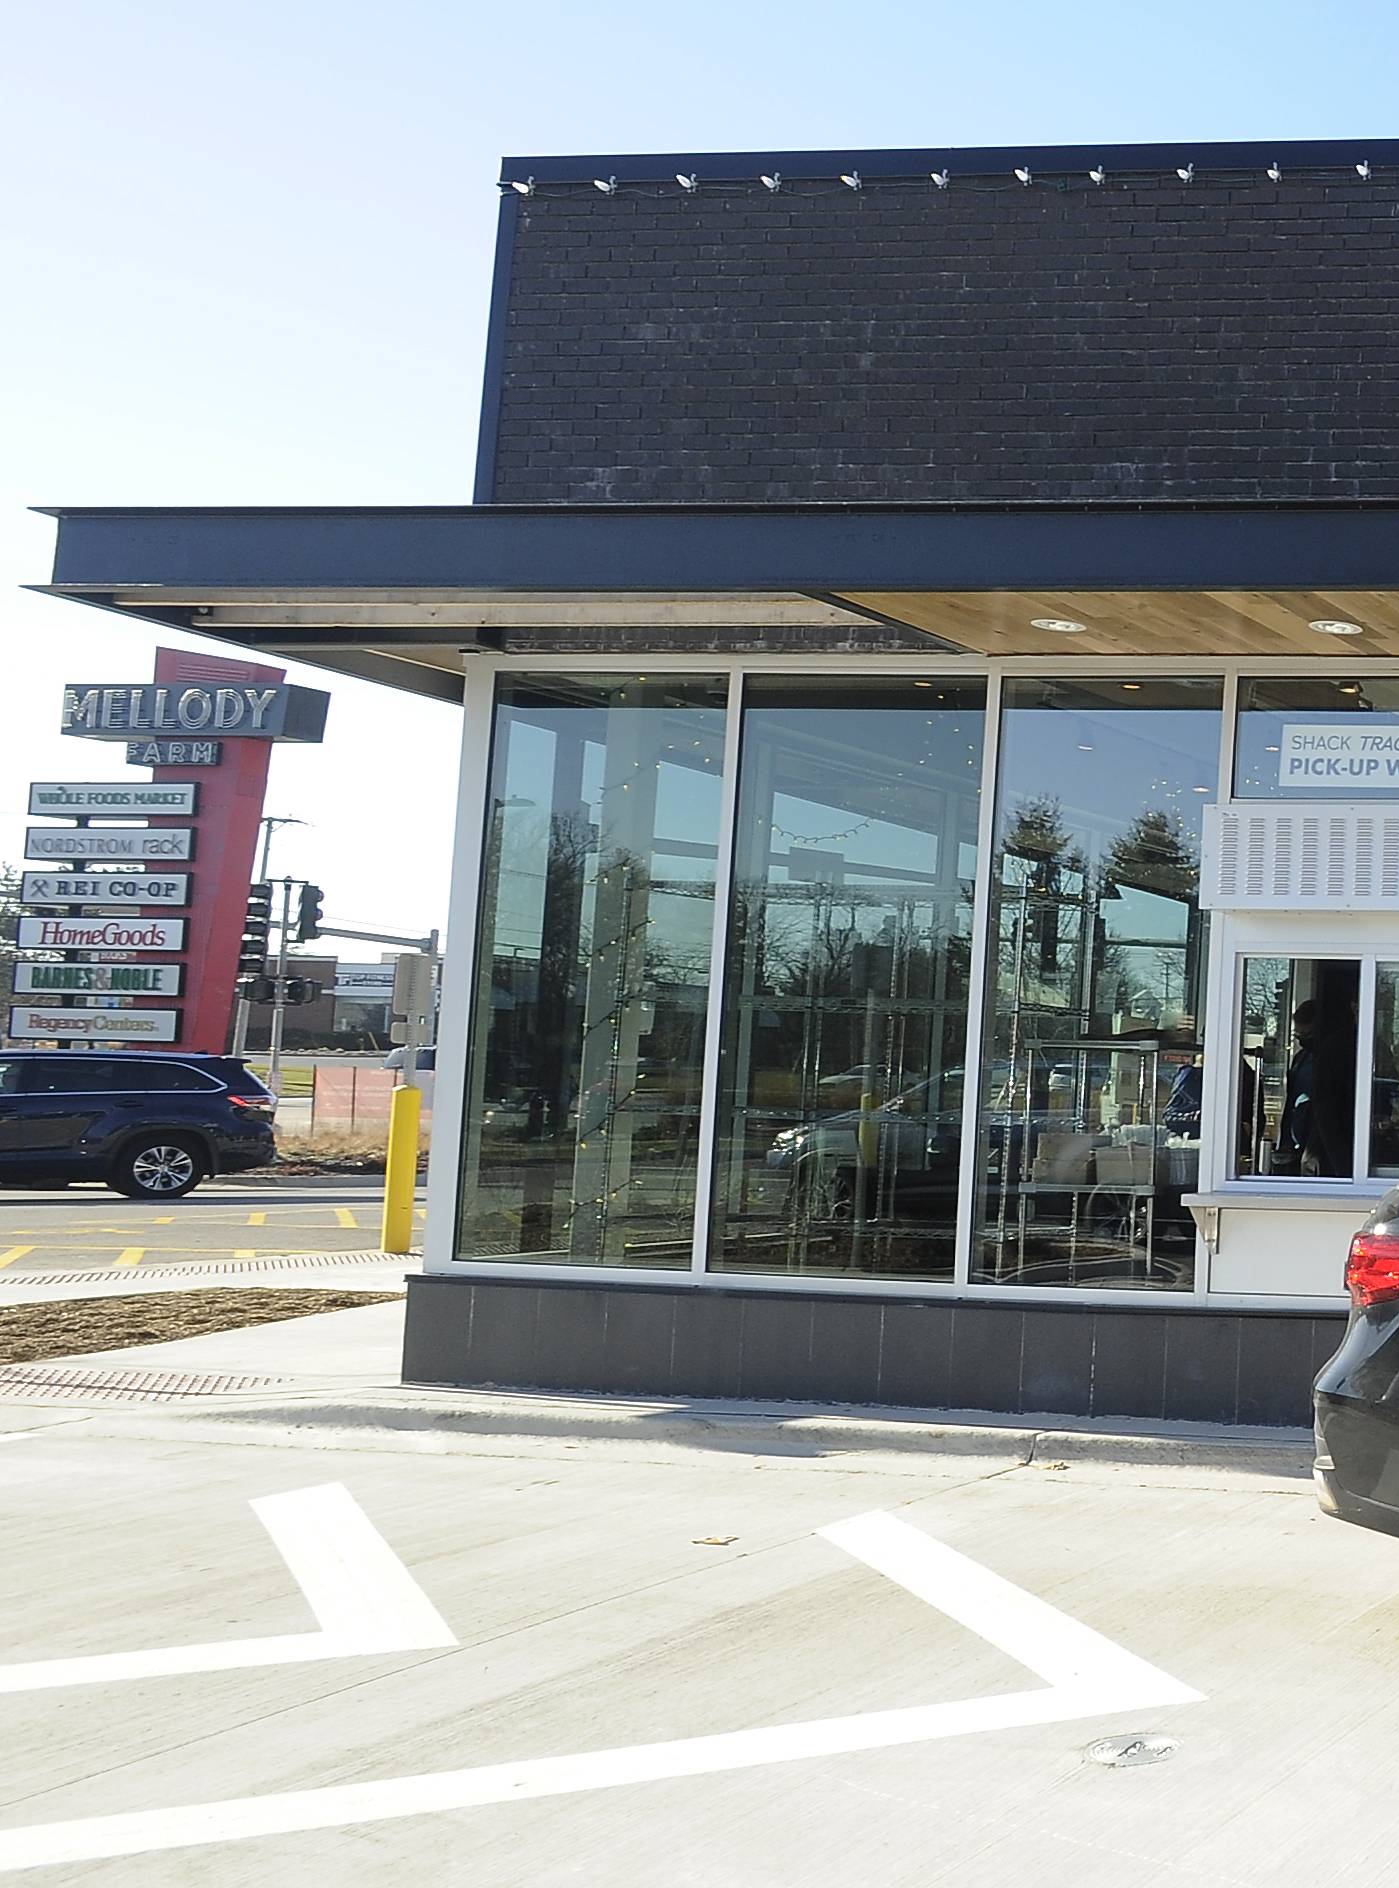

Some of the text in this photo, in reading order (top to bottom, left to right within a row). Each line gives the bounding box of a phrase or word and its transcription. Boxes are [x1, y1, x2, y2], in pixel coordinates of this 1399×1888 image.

[62, 688, 277, 729] MELLODY
[127, 742, 213, 763] FARM
[1290, 735, 1351, 751] SHACK
[1289, 758, 1380, 776] PICK-UP
[37, 787, 187, 805] WHOLE FOODS MARKET
[31, 834, 184, 855] NORDSTROM rack
[56, 880, 179, 898] REI CO-OP
[38, 921, 166, 947] HomeGoods
